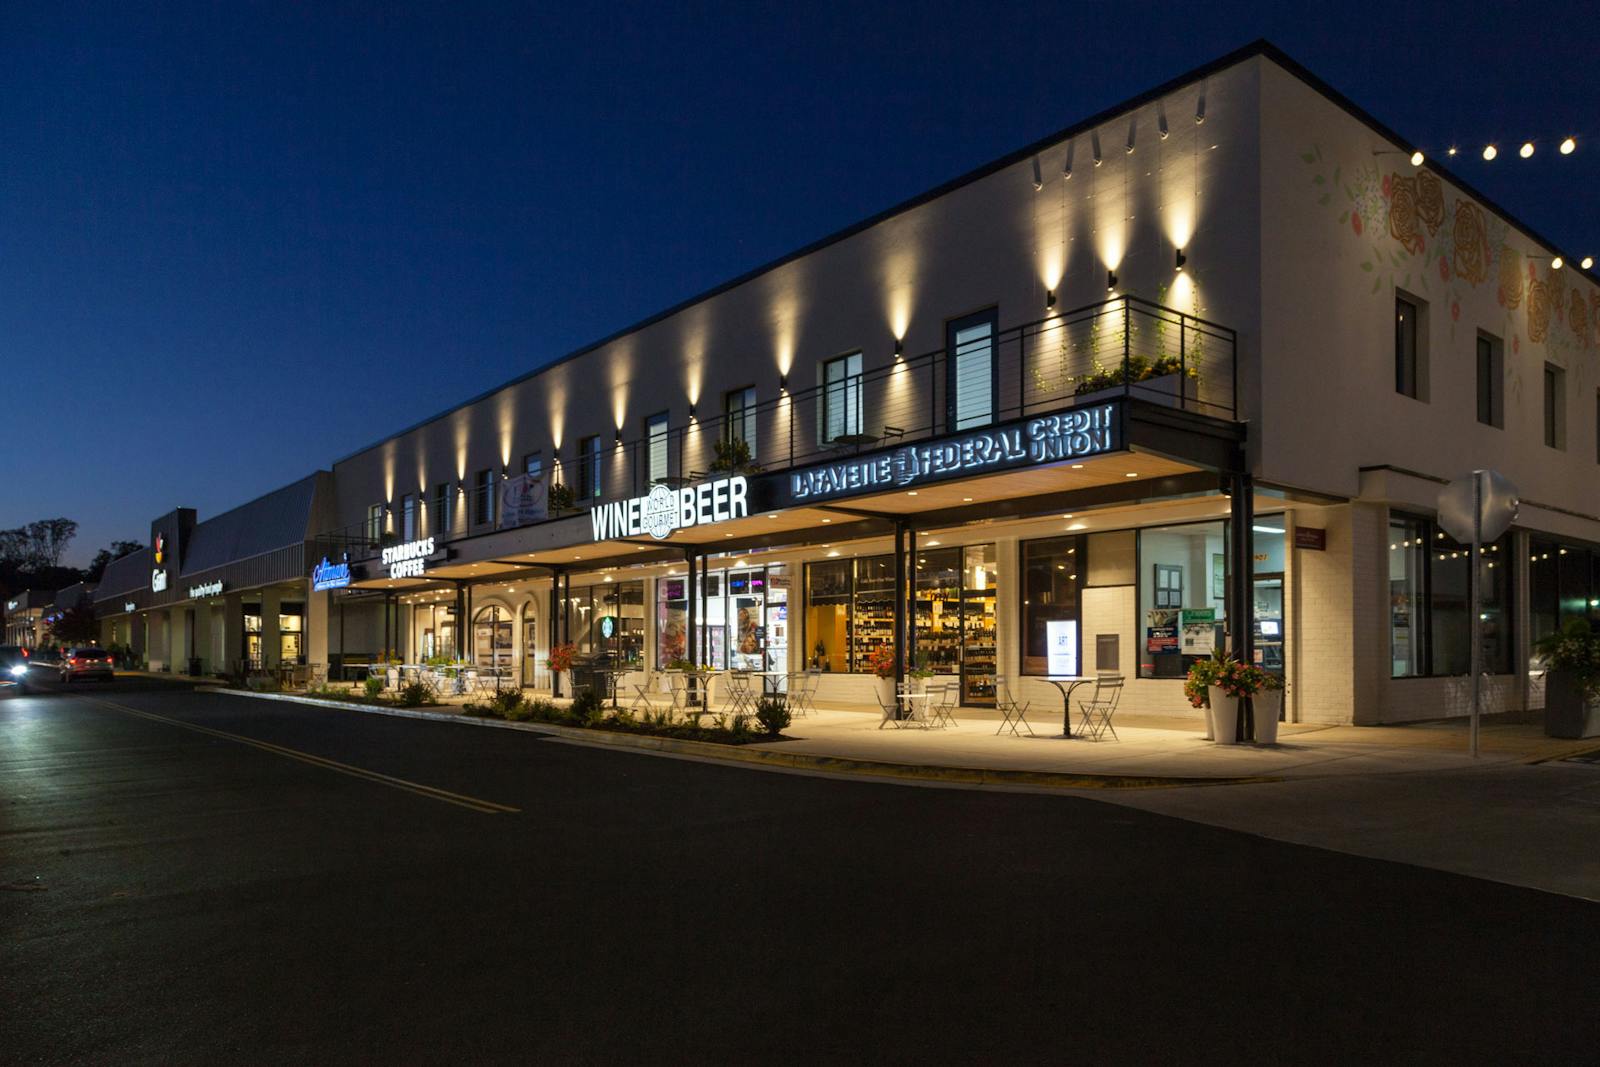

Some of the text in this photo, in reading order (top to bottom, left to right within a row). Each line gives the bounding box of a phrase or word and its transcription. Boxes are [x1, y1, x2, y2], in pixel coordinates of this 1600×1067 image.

[1028, 405, 1113, 442] CREDIT
[1029, 428, 1112, 464] UNION
[790, 429, 1026, 498] LAFAYETTE FEDERAL
[591, 498, 640, 541] WINE
[680, 475, 748, 528] BEER
[647, 494, 675, 511] WORLD
[642, 511, 678, 530] GOURMET
[382, 536, 435, 565] STARBUCKS
[390, 558, 425, 579] COFFEE
